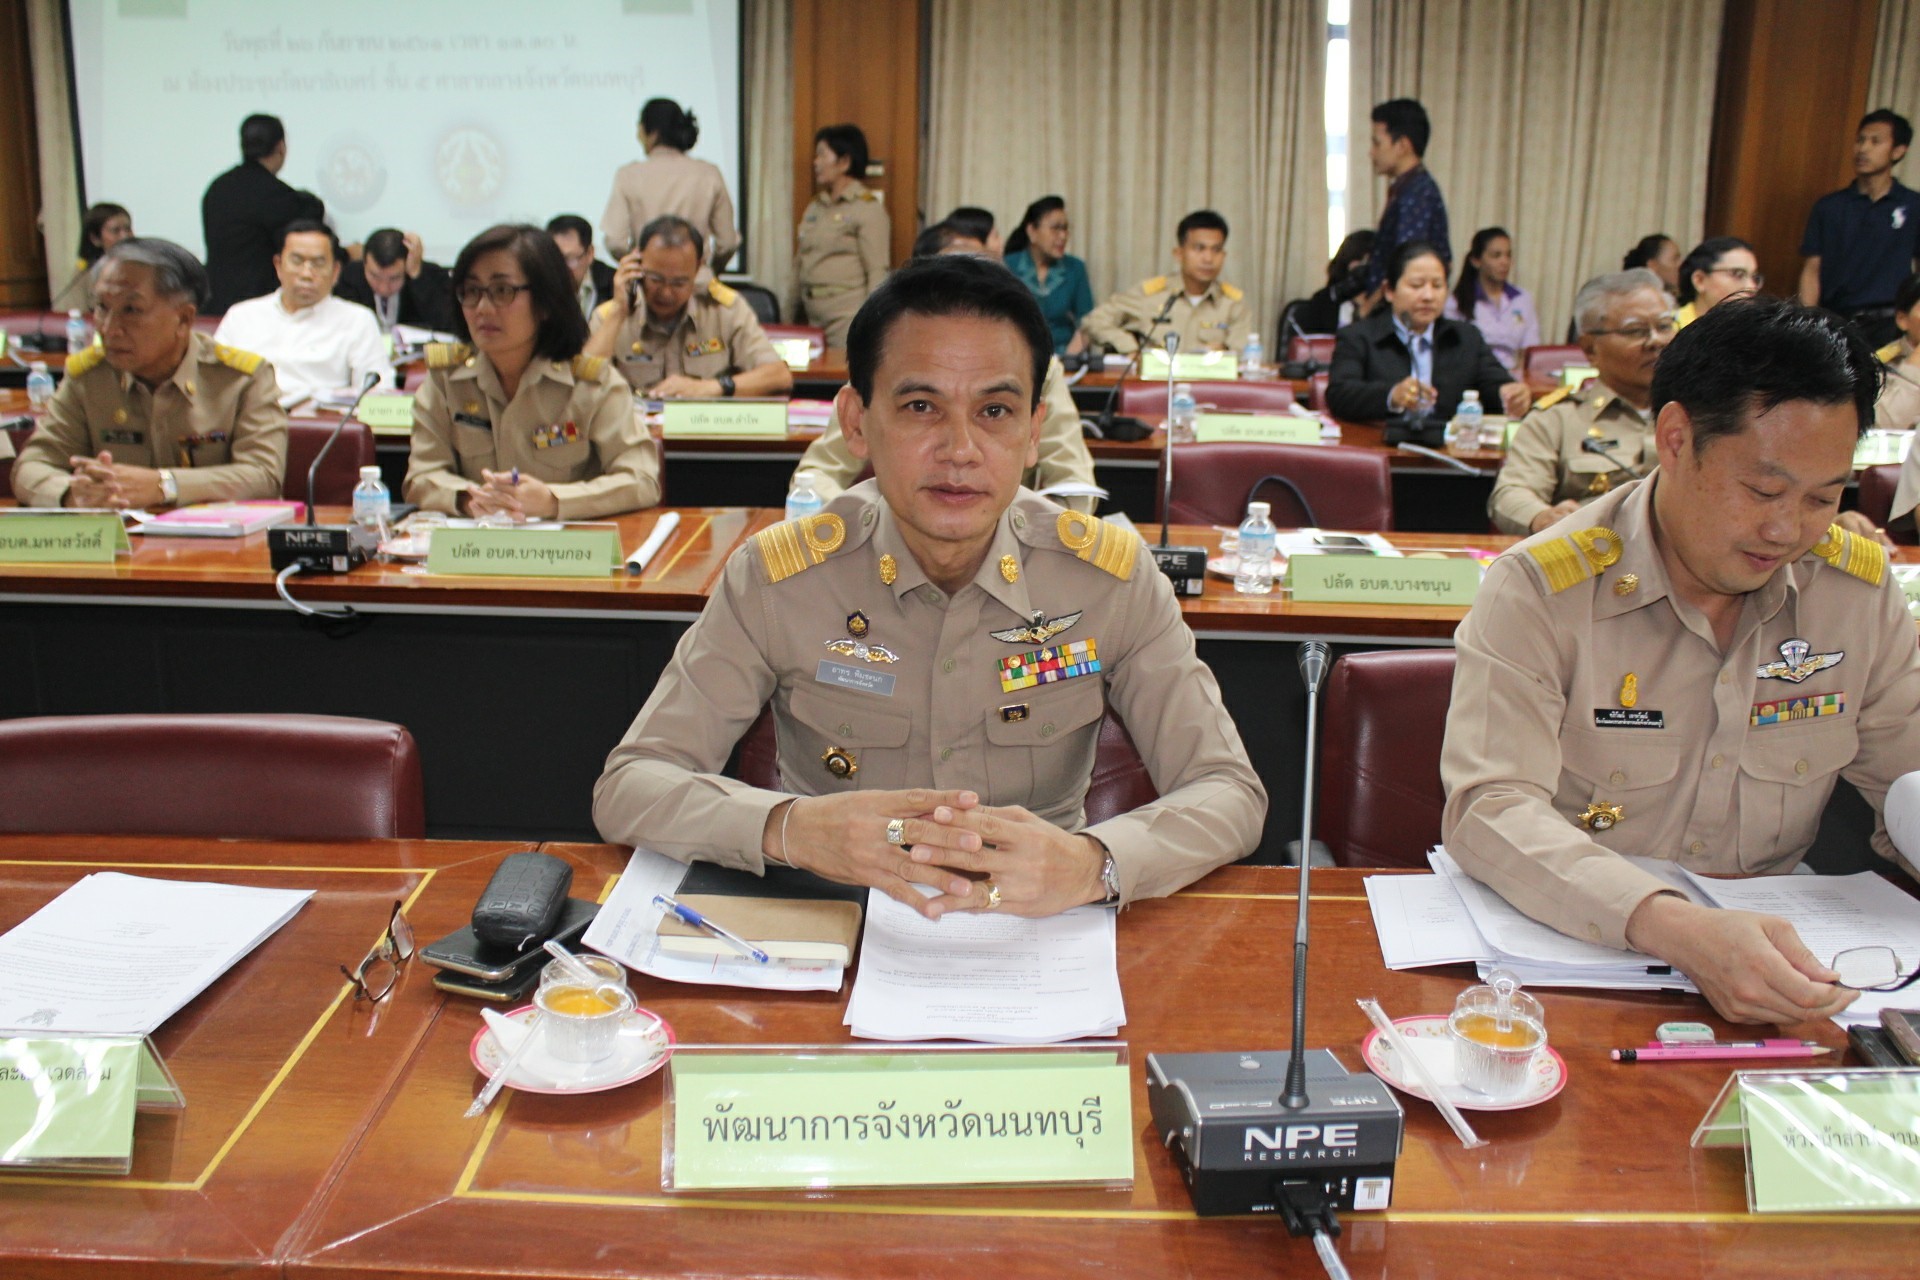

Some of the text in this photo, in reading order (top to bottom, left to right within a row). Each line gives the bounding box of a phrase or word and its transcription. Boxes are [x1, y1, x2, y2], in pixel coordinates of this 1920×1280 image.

[285, 532, 331, 543] NPE
[452, 542, 481, 559] ปลัด
[1323, 573, 1354, 590] ปลัด
[702, 1096, 1102, 1149] พัฒนาการจังหวัดนนทบุรี
[1244, 1123, 1359, 1151] NPE
[1244, 1149, 1357, 1162] RESEARCH
